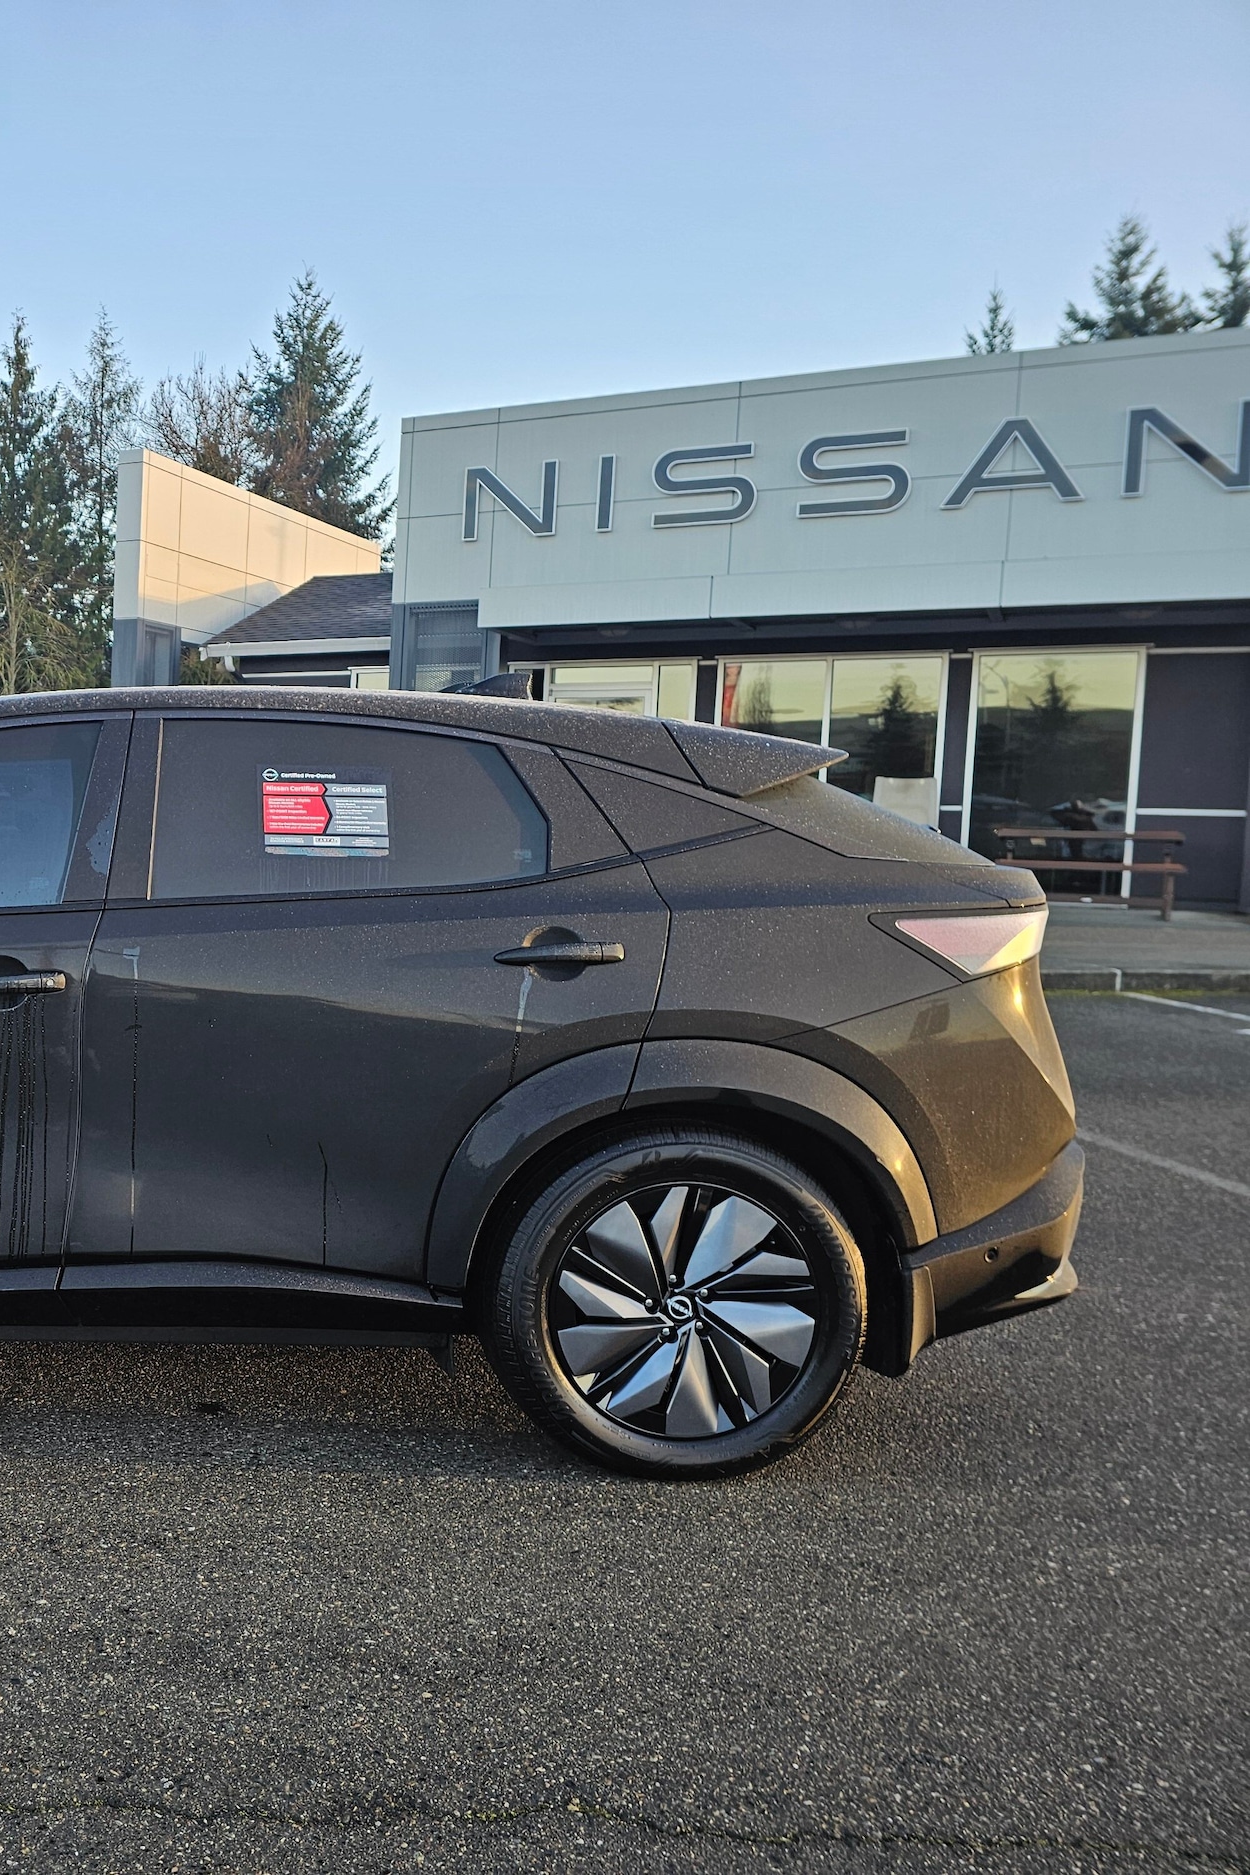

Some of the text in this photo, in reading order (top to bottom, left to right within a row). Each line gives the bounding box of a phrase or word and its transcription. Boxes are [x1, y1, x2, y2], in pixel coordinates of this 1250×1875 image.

[462, 398, 1250, 542] NISSAN
[305, 772, 336, 780] Pre-Owned
[331, 785, 383, 794] Certified Select
